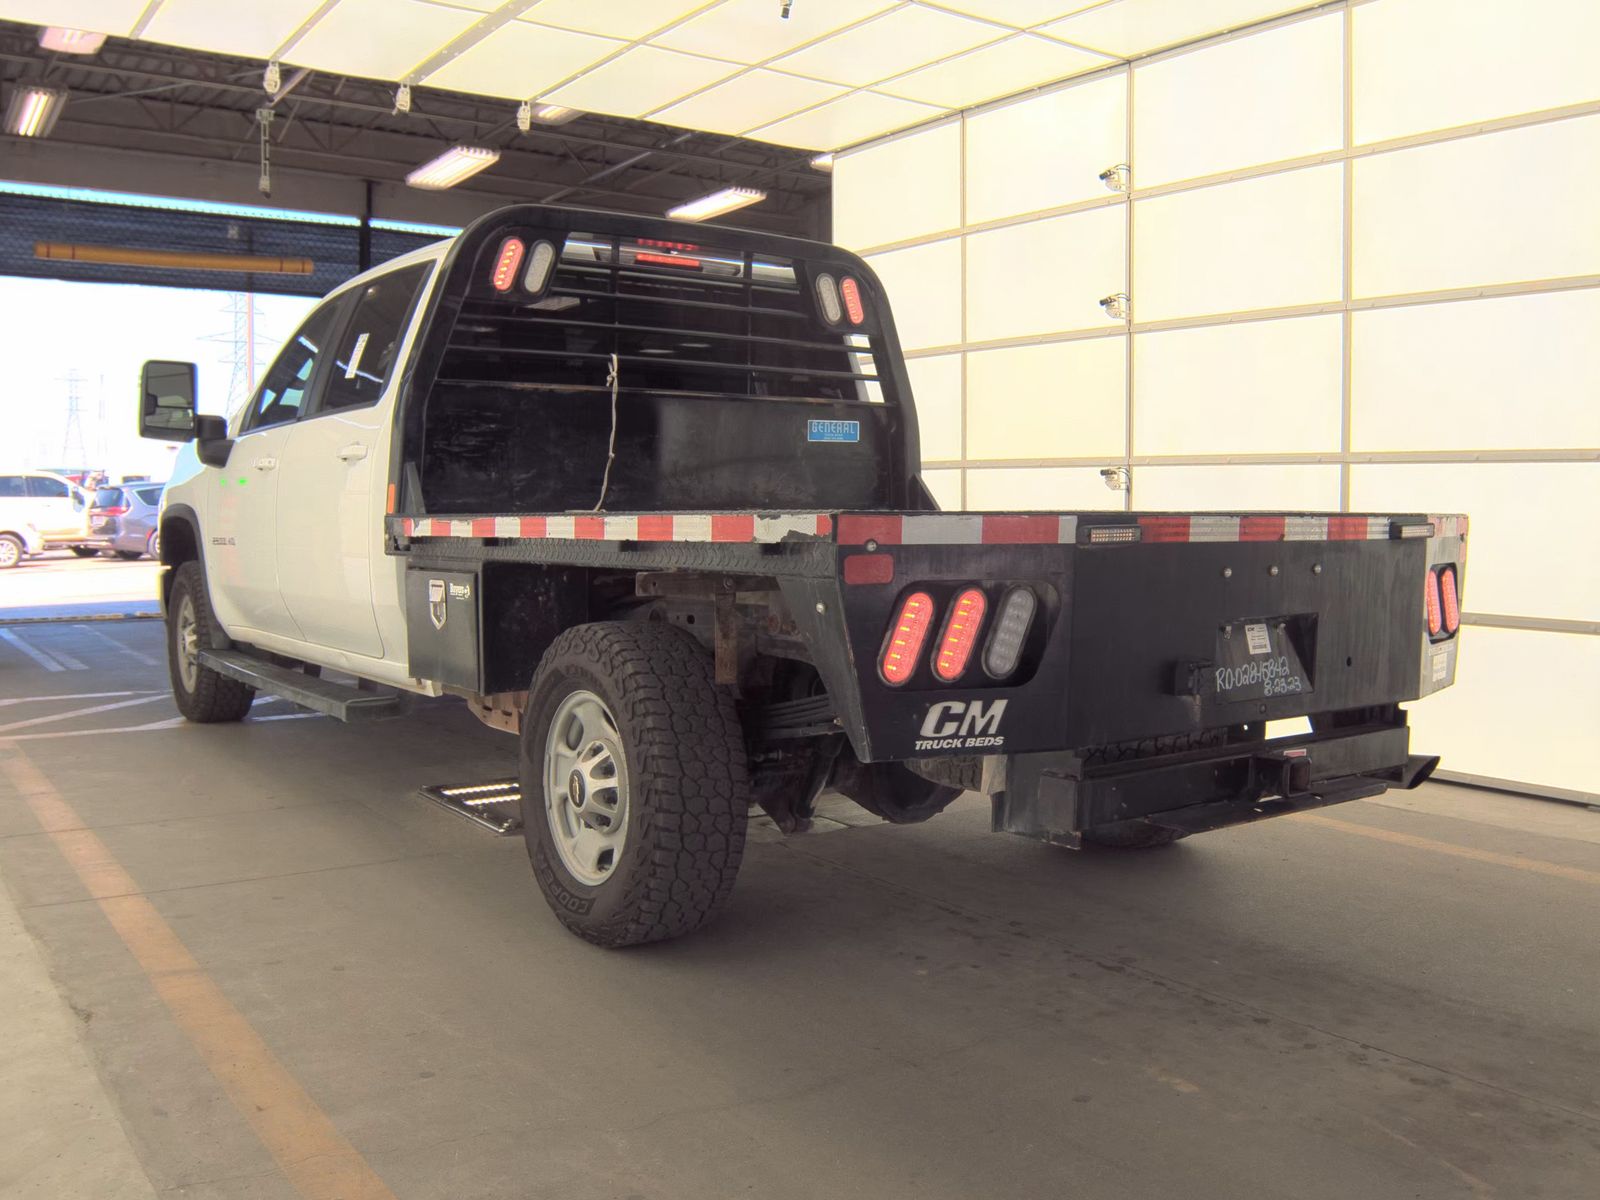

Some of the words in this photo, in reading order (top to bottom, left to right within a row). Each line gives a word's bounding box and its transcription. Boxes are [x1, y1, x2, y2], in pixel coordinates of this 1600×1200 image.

[812, 421, 855, 434] GENERAL
[920, 699, 1008, 738] CM
[915, 739, 963, 750] TRUCK
[965, 736, 1005, 748] BEDS
